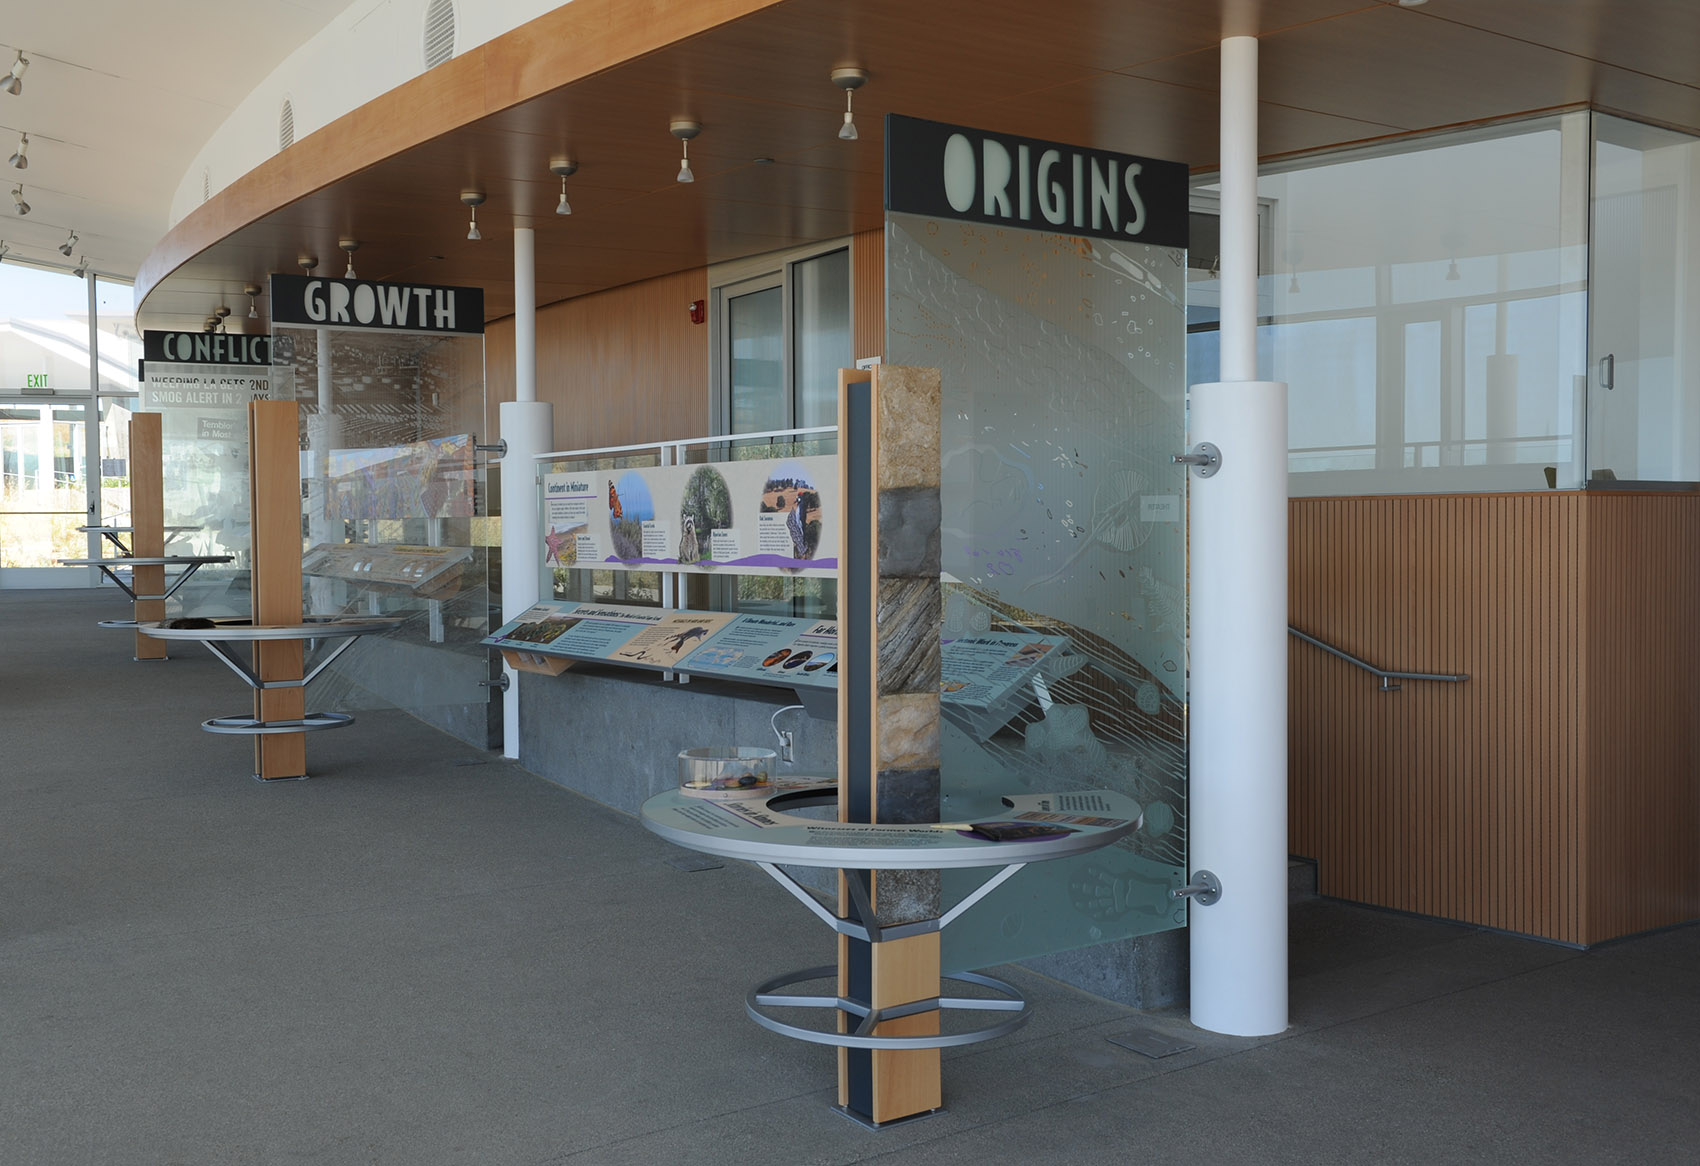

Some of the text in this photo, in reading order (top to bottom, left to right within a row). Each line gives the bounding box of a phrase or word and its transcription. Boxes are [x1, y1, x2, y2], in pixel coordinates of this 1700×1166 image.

[943, 133, 1147, 235] ORIGINS
[304, 280, 456, 329] GROWTH
[27, 374, 48, 388] EXIT
[151, 377, 269, 391] WEEPING LA GETS 2ND
[152, 391, 183, 403] SMOG
[186, 391, 219, 404] ALERT
[222, 393, 232, 404] IN
[250, 393, 270, 401] AYS
[201, 429, 210, 437] in
